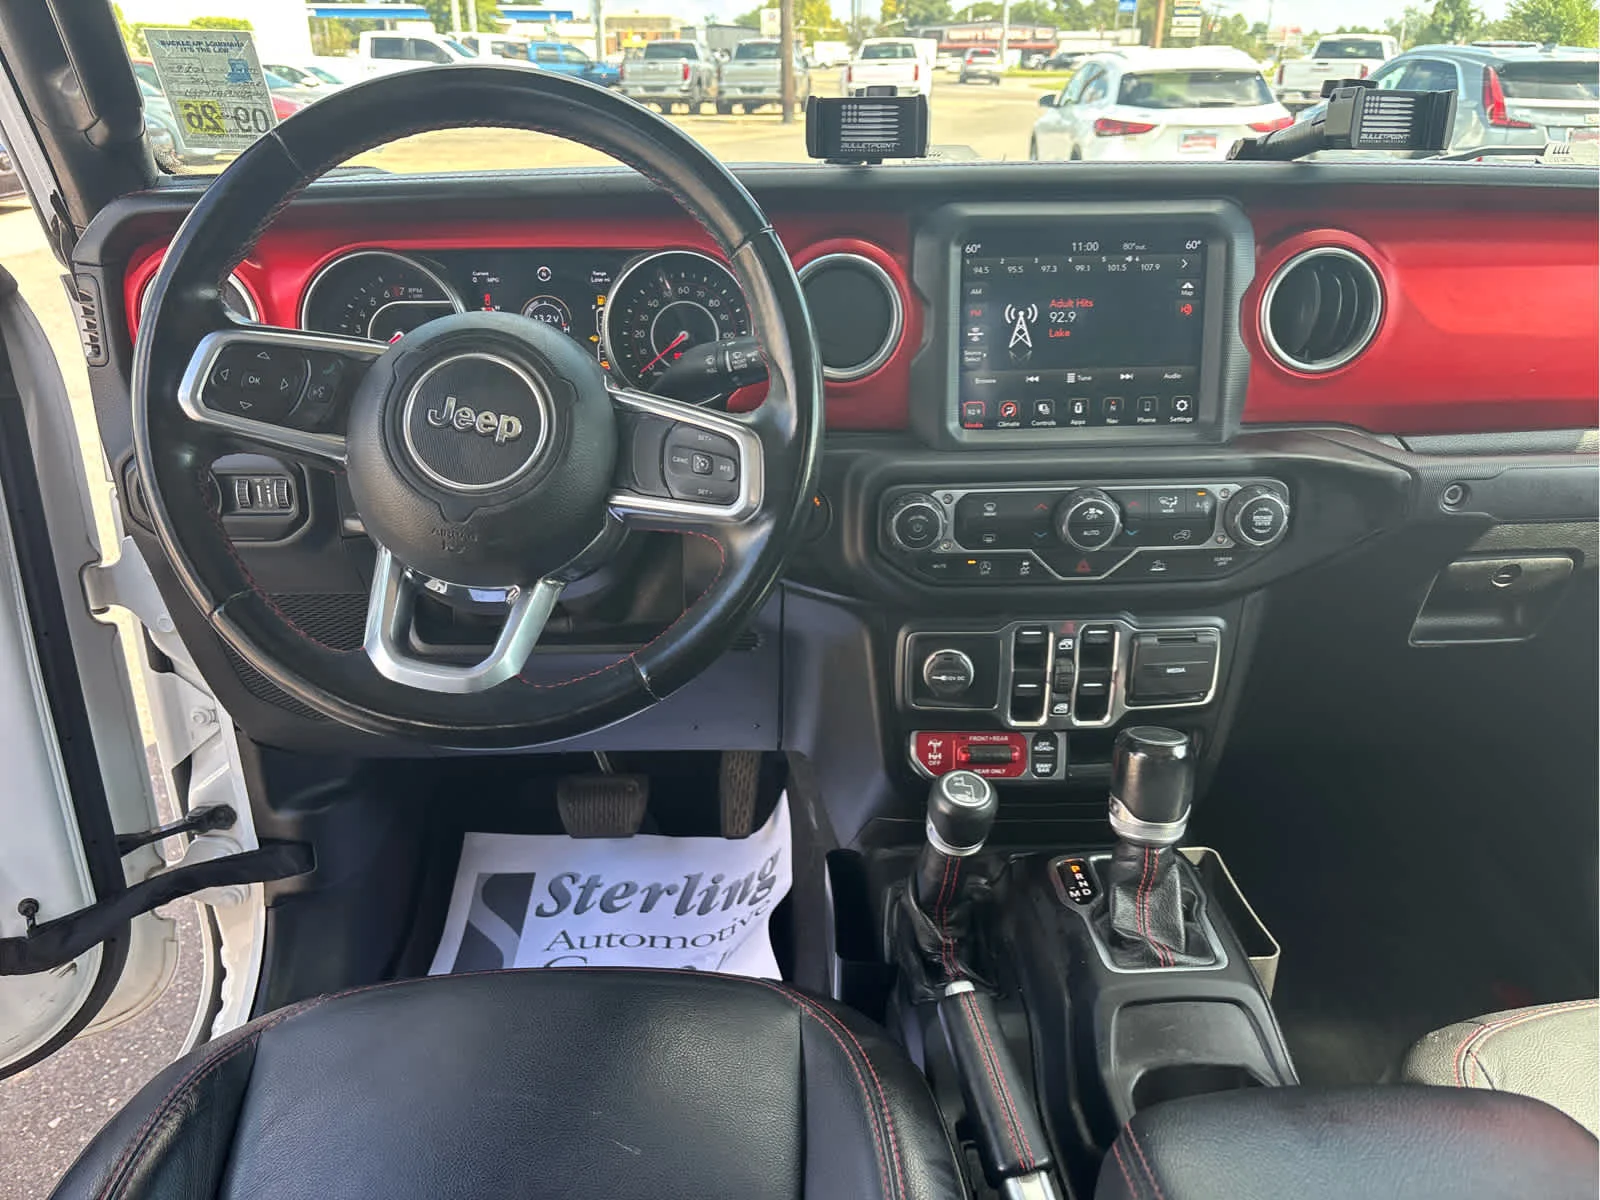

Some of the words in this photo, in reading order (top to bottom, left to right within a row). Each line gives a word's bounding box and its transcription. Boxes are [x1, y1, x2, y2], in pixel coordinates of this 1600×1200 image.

[1072, 242, 1099, 251] 11:00
[1141, 263, 1160, 271] 107.9
[383, 289, 390, 298] 6
[677, 286, 690, 295] 60
[370, 297, 377, 306] 5
[648, 299, 659, 307] 40
[709, 299, 720, 307] 80
[1049, 299, 1074, 308] Adult
[1049, 311, 1077, 323] 92.9
[355, 325, 361, 334] 3
[634, 330, 645, 338] 20
[1049, 328, 1071, 338] Lake
[248, 376, 261, 384] OK
[427, 396, 523, 443] Jeep
[535, 848, 782, 918] Sterling
[543, 902, 770, 952] Automotive
